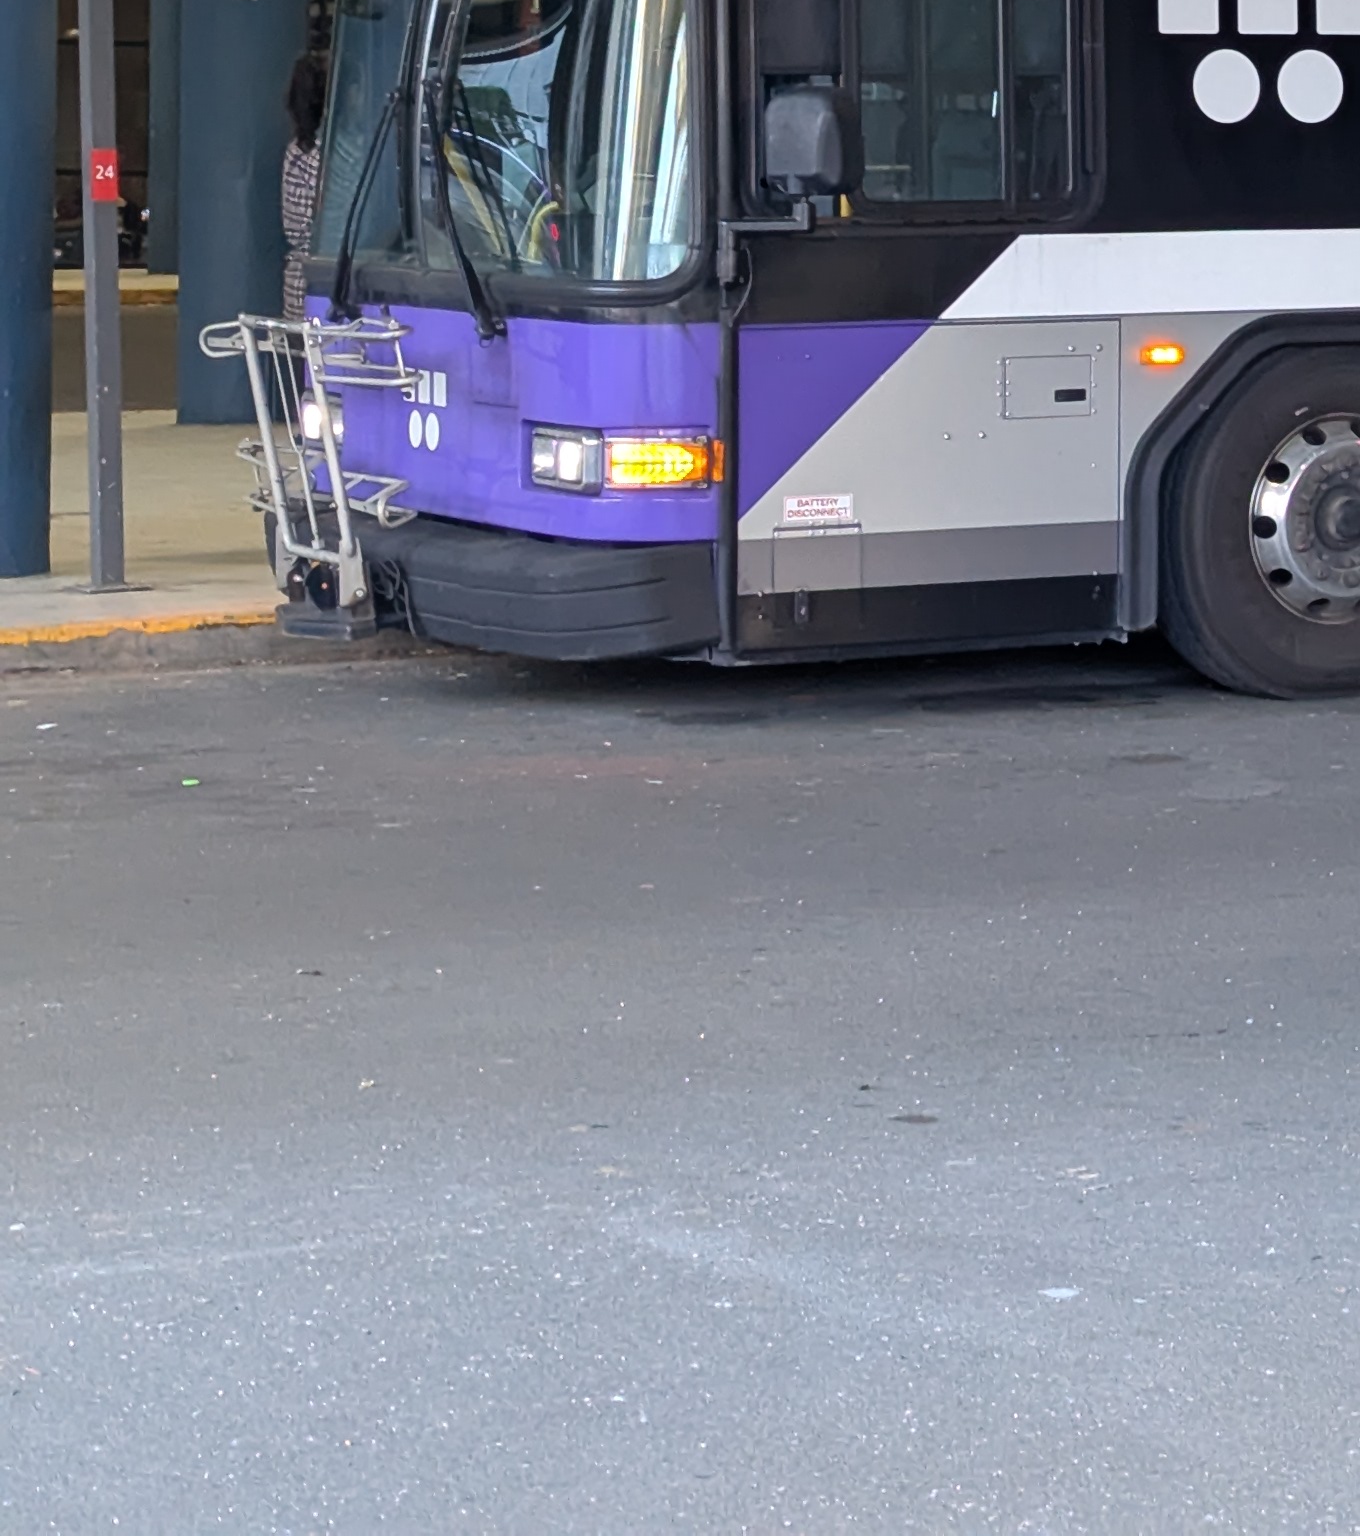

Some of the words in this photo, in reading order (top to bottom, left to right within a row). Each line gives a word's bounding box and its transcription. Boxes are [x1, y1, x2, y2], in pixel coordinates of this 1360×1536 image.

[95, 164, 115, 180] 24
[797, 498, 840, 507] BATTERY
[787, 507, 848, 518] DISCONNECT
